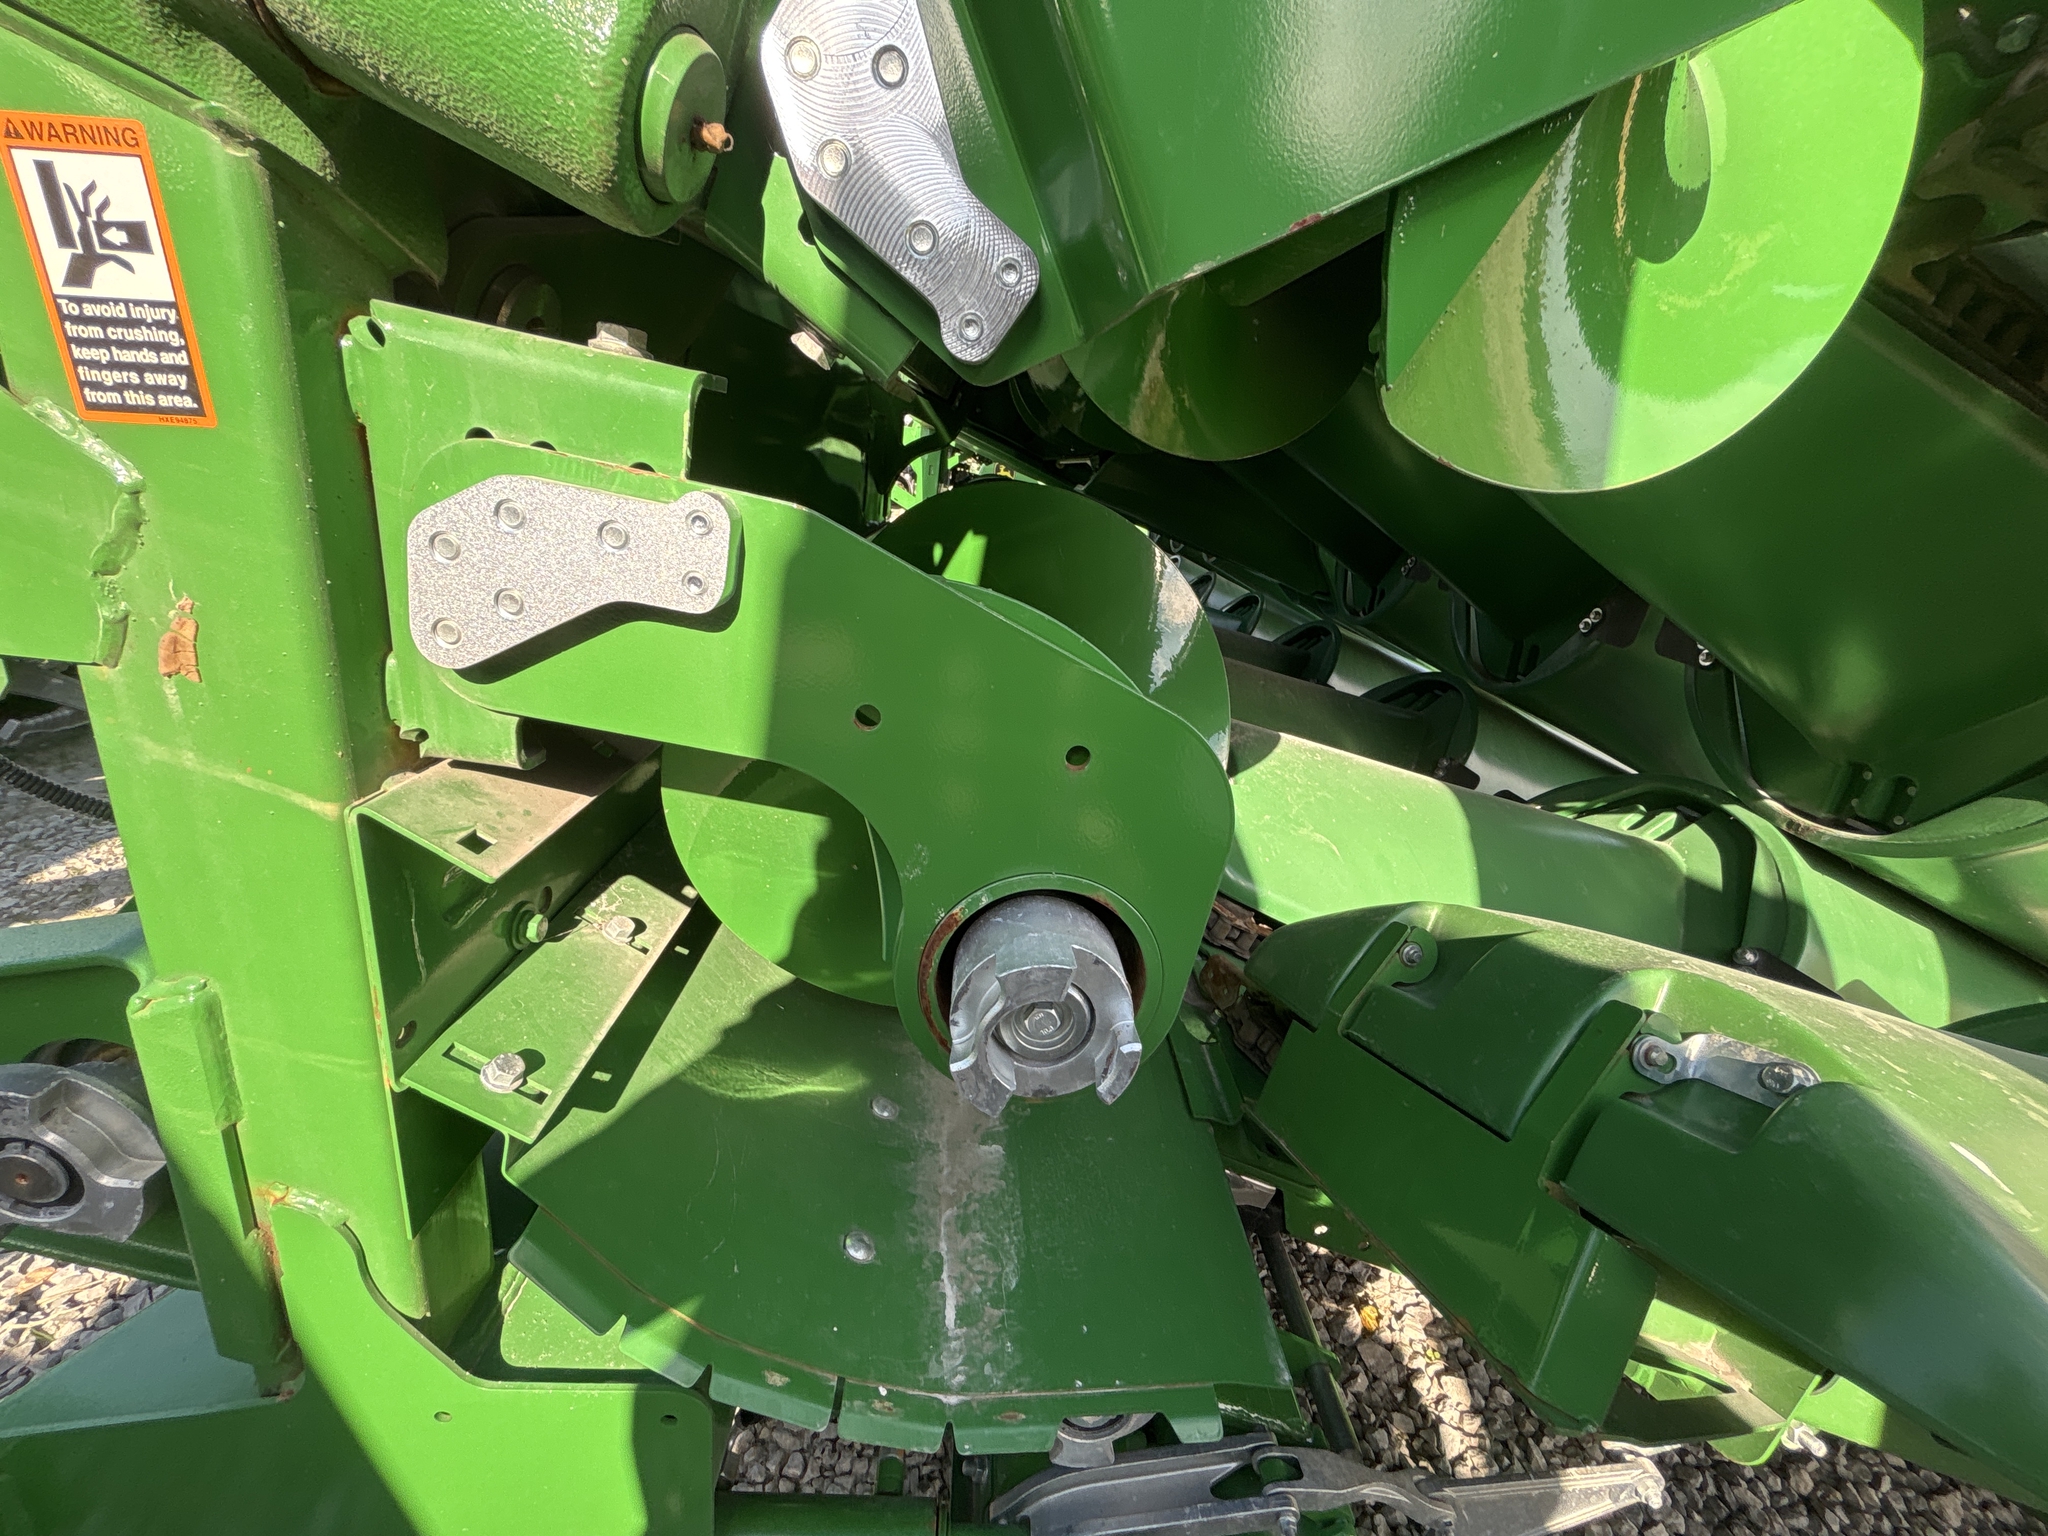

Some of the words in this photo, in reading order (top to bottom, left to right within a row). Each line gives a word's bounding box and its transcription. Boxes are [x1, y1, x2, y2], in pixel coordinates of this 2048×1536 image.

[21, 120, 140, 148] WARNING
[57, 299, 80, 316] To
[83, 302, 127, 319] avoid
[64, 321, 104, 339] from
[106, 325, 186, 347] crushing,
[70, 344, 110, 364] keep
[111, 346, 159, 364] hands
[160, 350, 190, 366] and
[77, 366, 140, 386] fingers
[143, 372, 187, 390] away
[83, 388, 122, 405] from
[123, 390, 156, 406] this
[157, 396, 199, 409] area.
